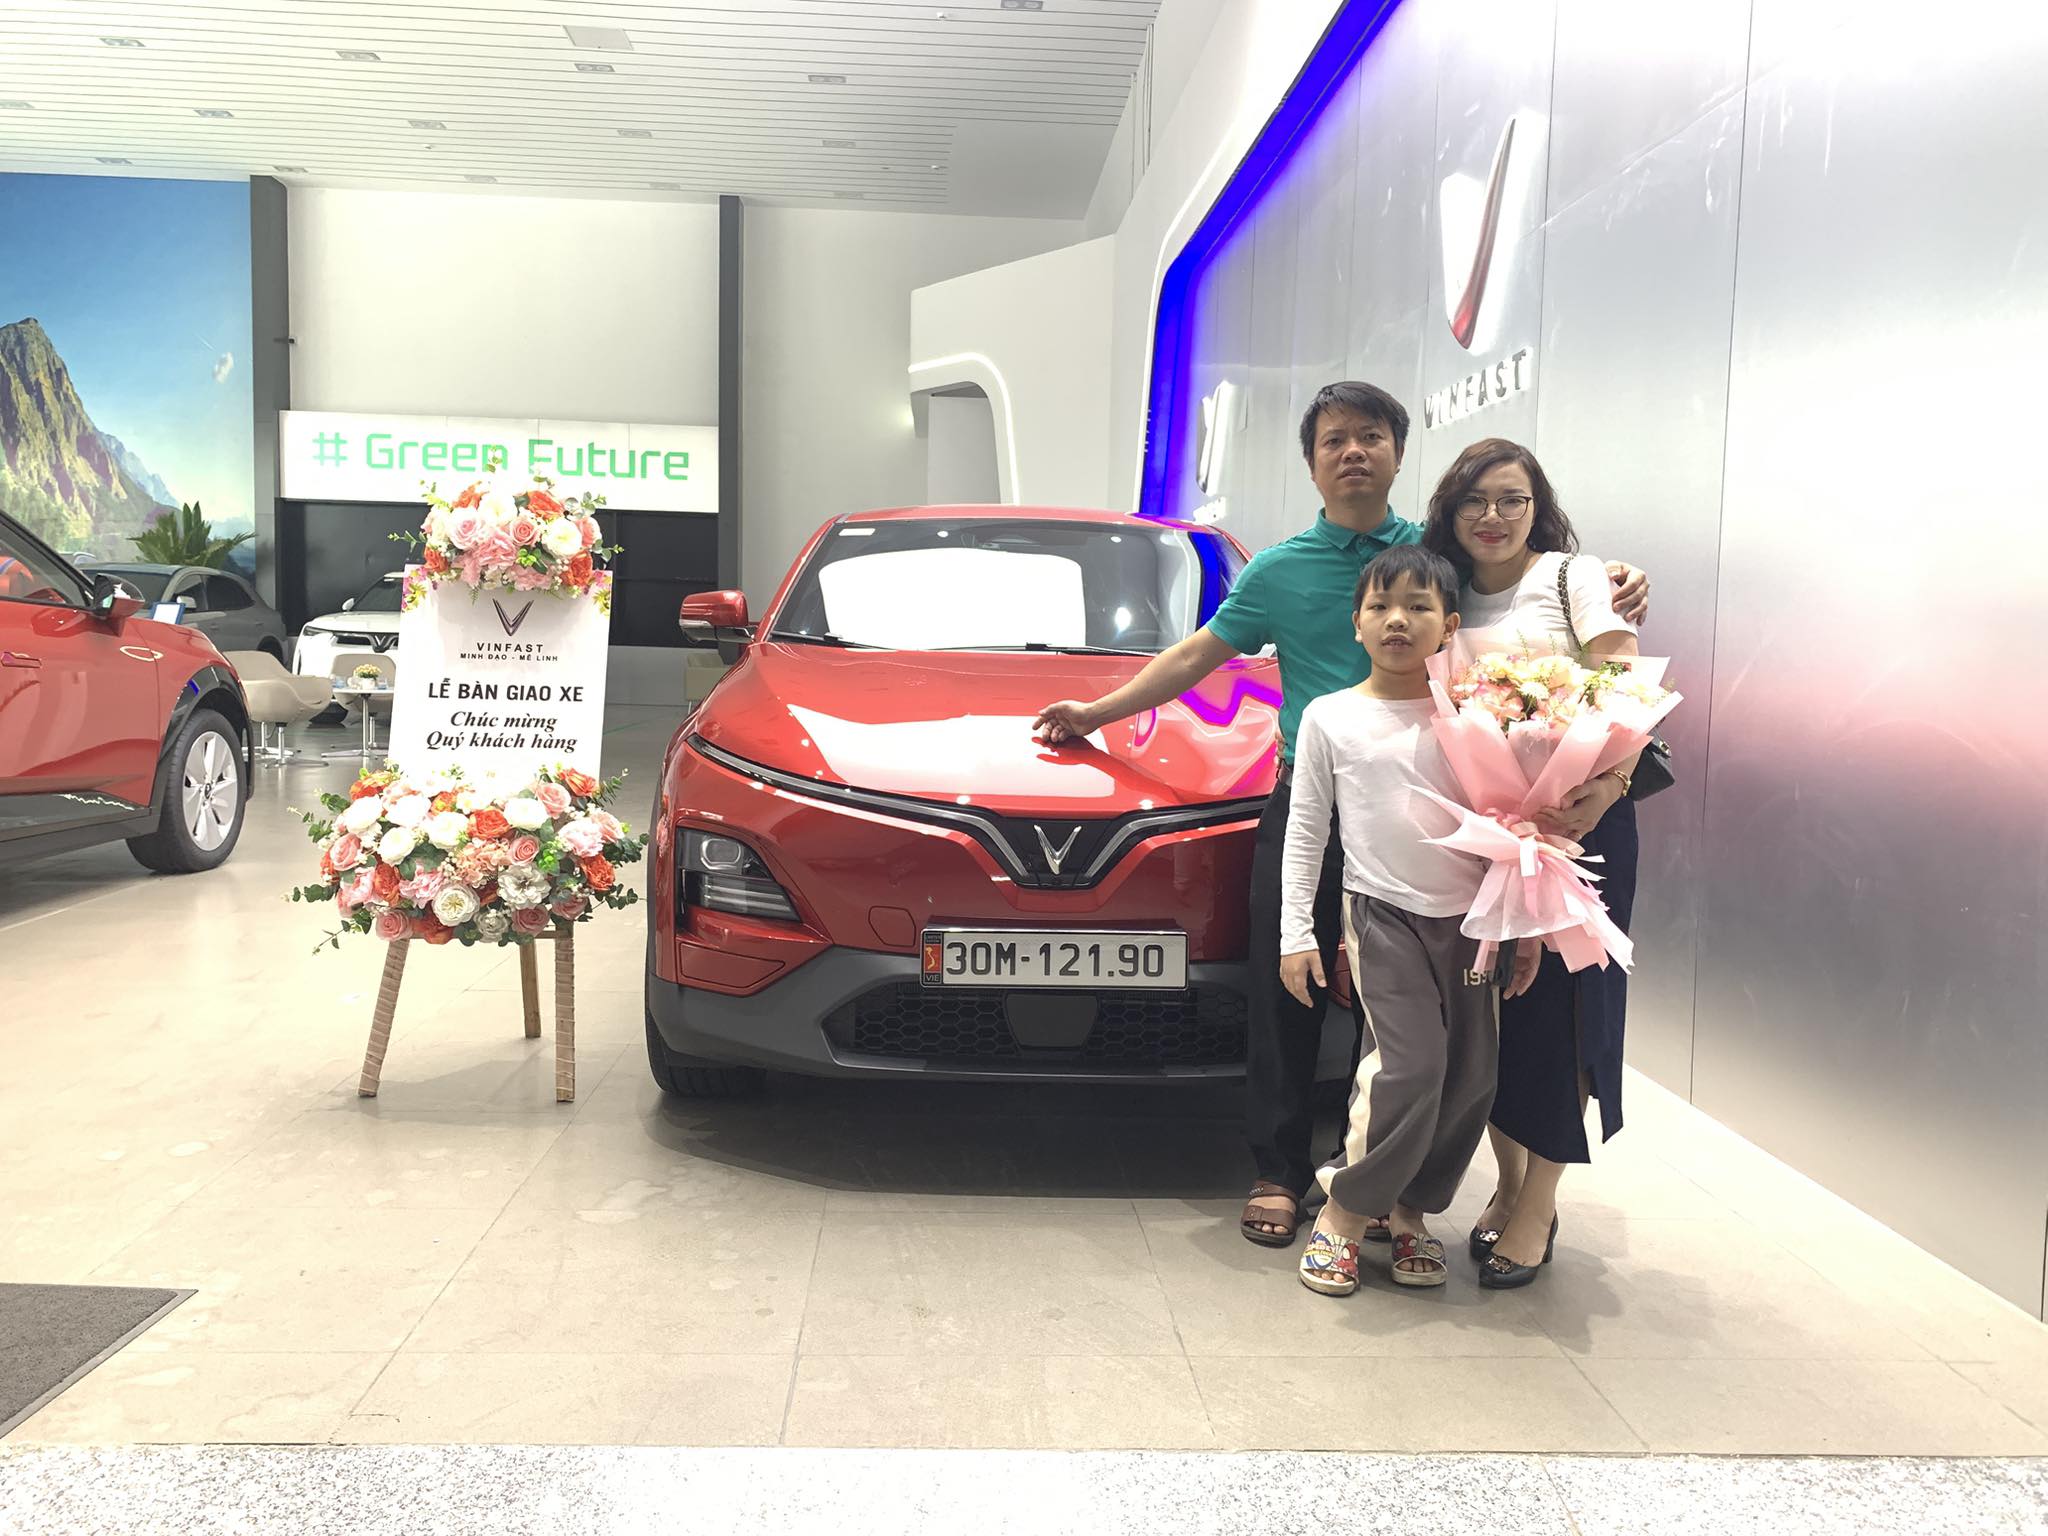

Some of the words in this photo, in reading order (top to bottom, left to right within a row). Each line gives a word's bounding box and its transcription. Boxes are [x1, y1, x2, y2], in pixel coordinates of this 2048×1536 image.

[1424, 349, 1528, 429] VINFAST
[366, 433, 509, 473] Green
[528, 438, 690, 481] Future
[476, 642, 544, 653] VINFAST
[428, 677, 451, 699] LỄ
[458, 681, 498, 700] BÀN
[506, 685, 551, 701] GIAO
[559, 686, 584, 702] XE
[450, 711, 499, 728] Chúc
[503, 713, 558, 733] mừng
[426, 731, 465, 751] Quý
[469, 732, 525, 748] khách
[531, 733, 578, 753] hàng
[946, 941, 1164, 977] 30M-121.90
[925, 973, 940, 982] VIE
